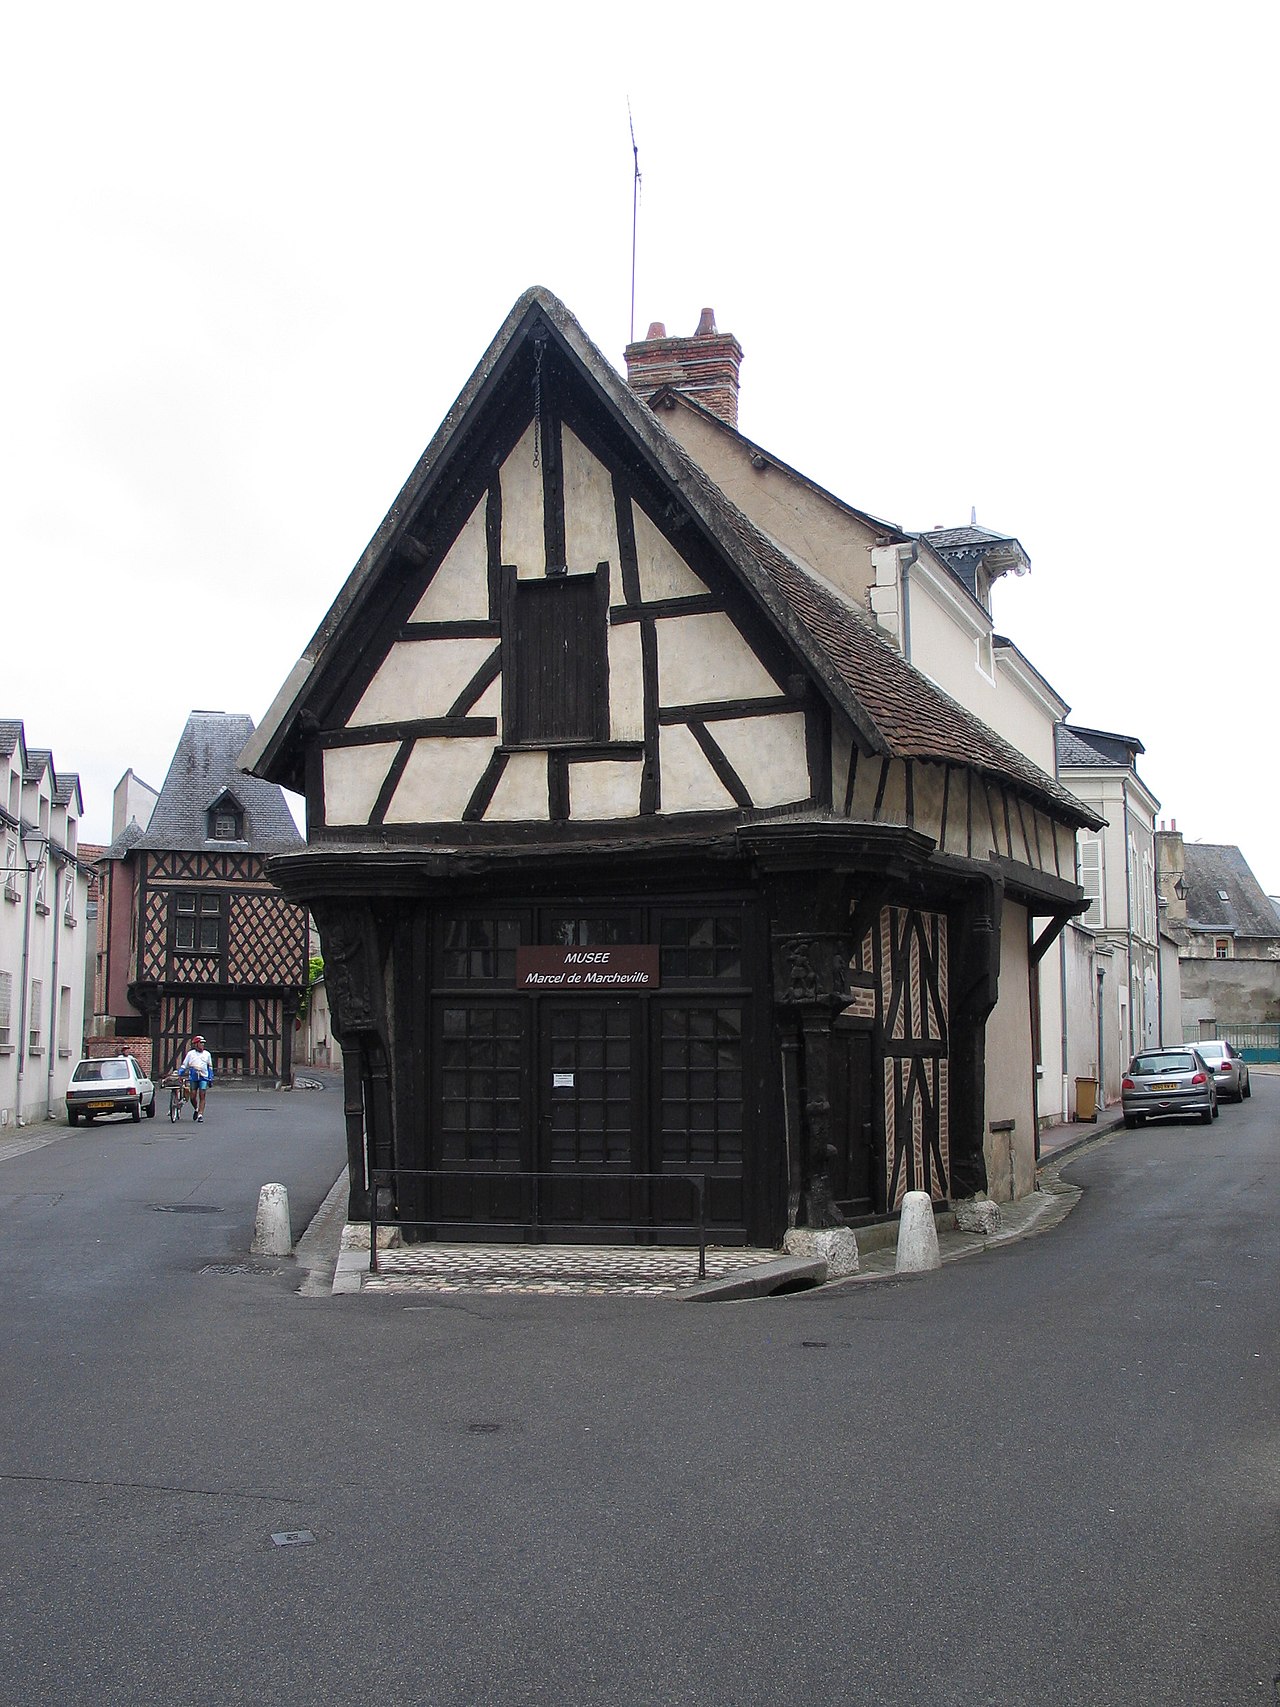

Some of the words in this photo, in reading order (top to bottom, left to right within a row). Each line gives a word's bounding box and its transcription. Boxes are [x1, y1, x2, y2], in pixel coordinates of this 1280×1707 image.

[564, 953, 610, 963] MUSEE
[525, 972, 565, 983] Marcel
[567, 973, 581, 983] de
[584, 972, 649, 983] Marcheville
